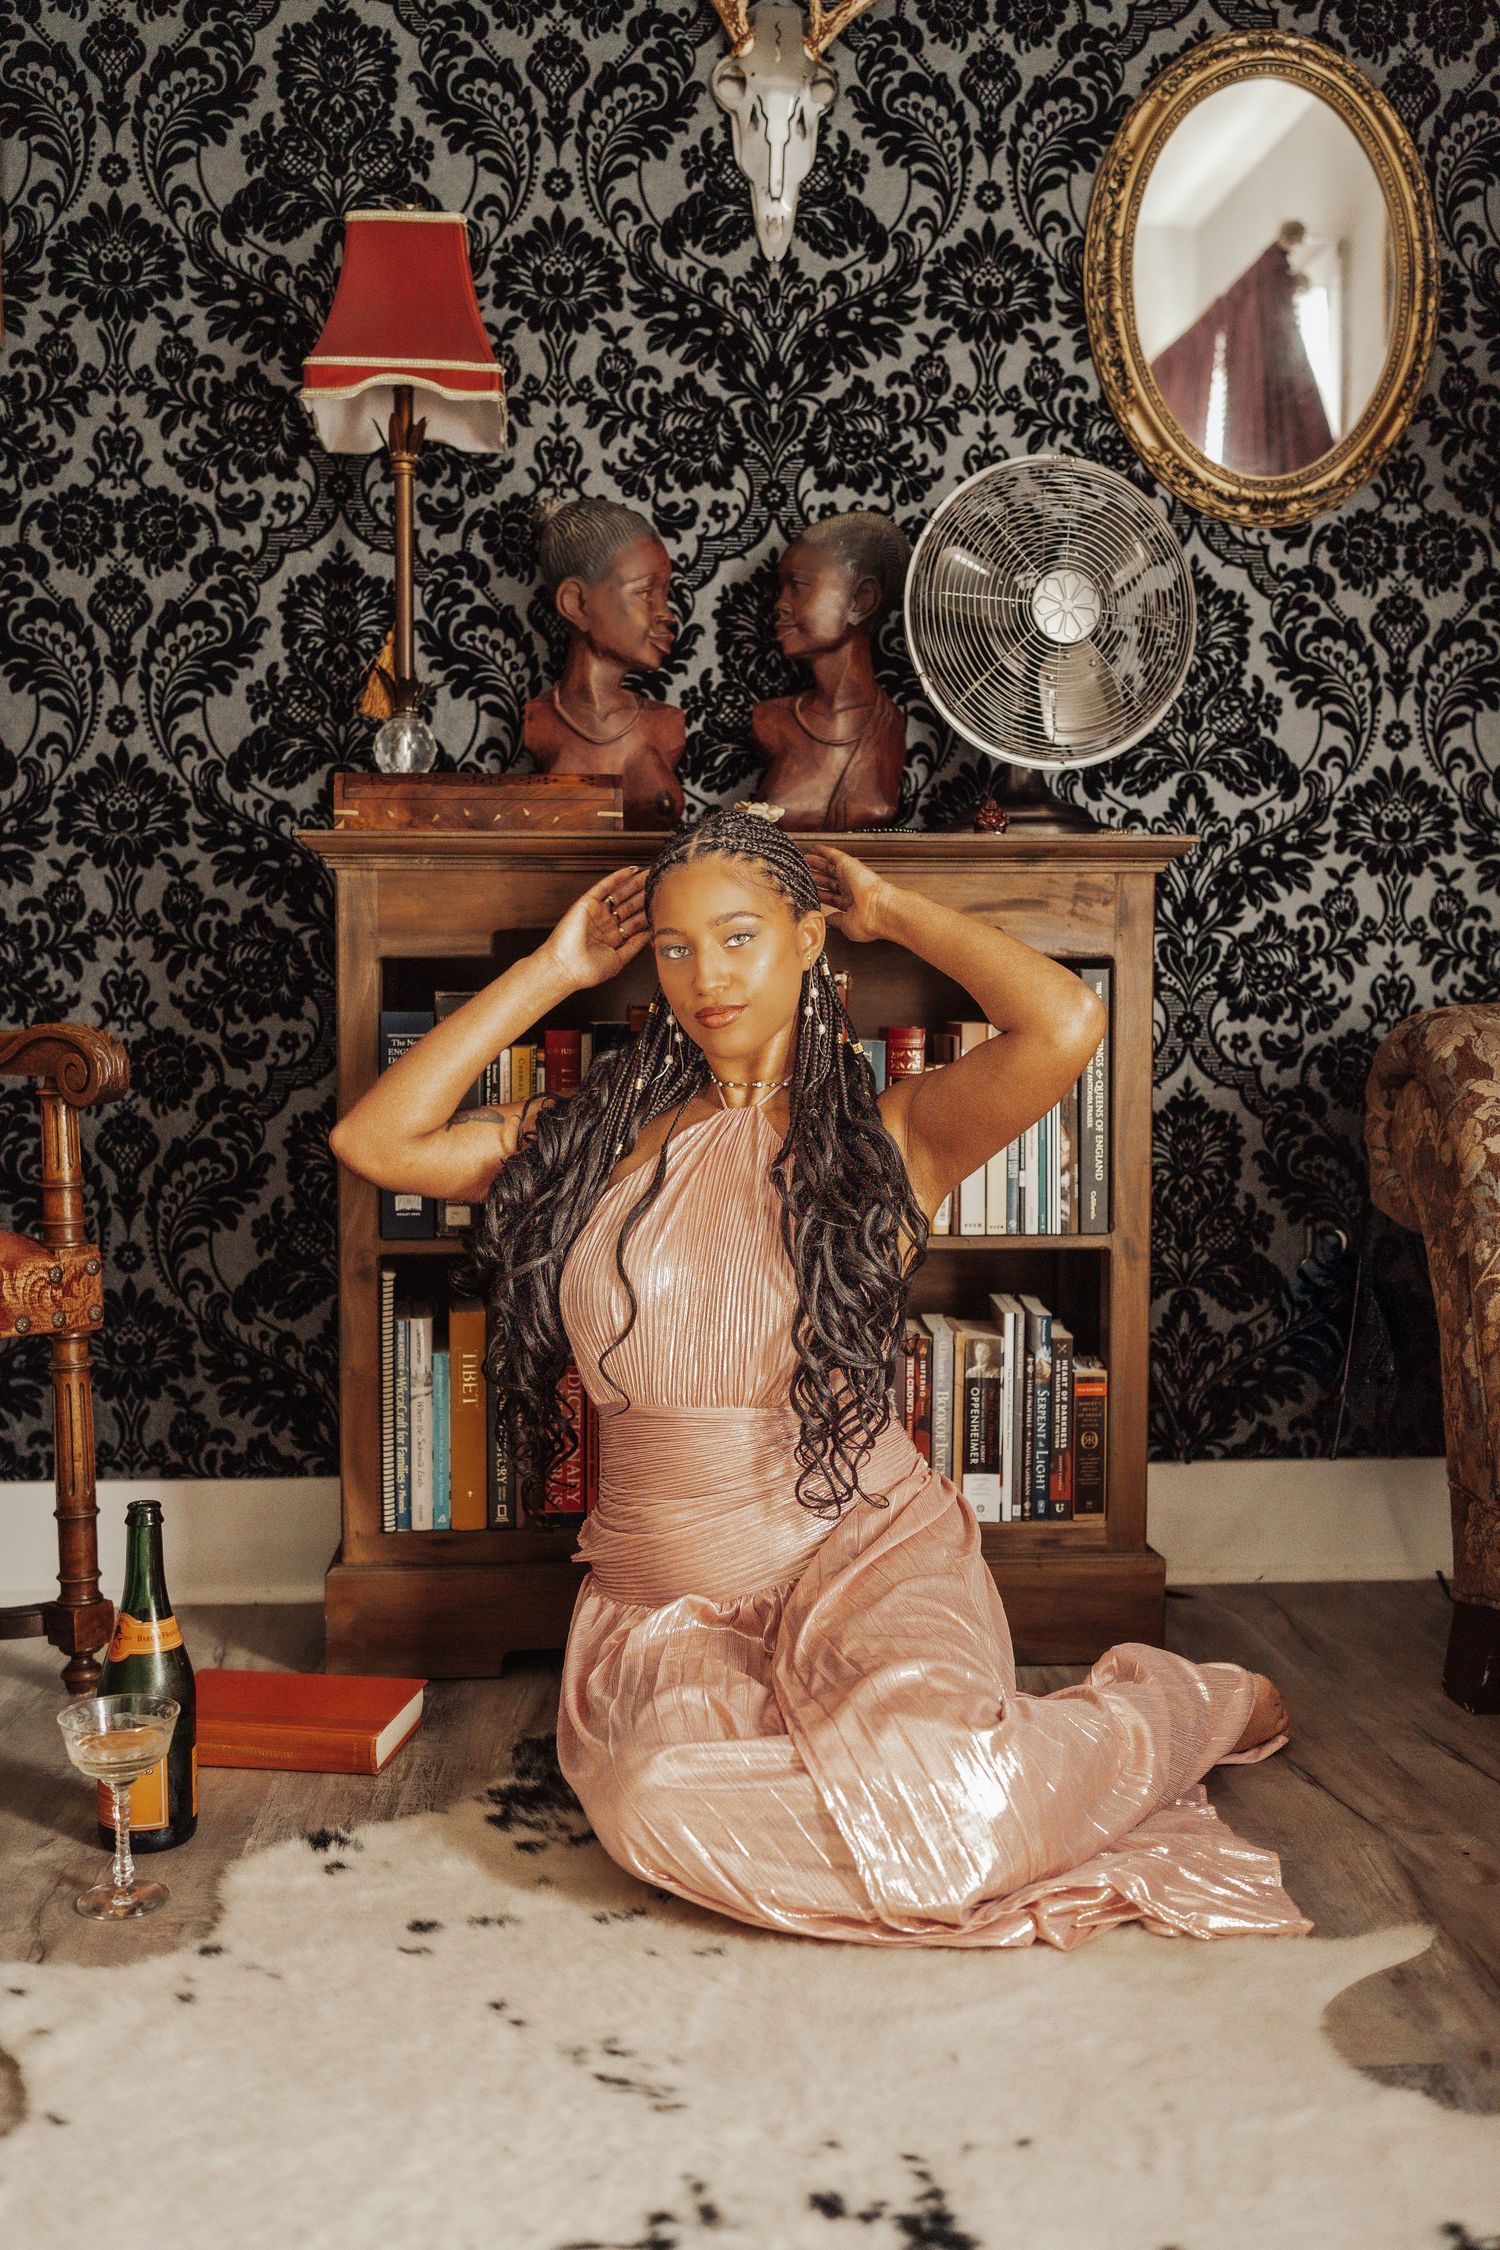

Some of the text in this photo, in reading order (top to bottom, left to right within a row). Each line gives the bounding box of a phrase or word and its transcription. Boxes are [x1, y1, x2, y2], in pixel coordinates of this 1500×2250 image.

[1094, 1080, 1103, 1117] QUEENS
[1095, 1119, 1103, 1133] OF
[1095, 1134, 1103, 1181] ENGLAND
[462, 1349, 478, 1408] TIBET
[906, 1358, 915, 1378] THE
[919, 1360, 927, 1398] INFERNO
[396, 1376, 408, 1429] WiccaCraft
[906, 1378, 915, 1413] CROWD
[1036, 1390, 1050, 1439] SERPENT
[1061, 1390, 1068, 1402] OF
[396, 1431, 408, 1445] for
[969, 1387, 980, 1465] OPPENHEIMER
[1060, 1404, 1068, 1449] DARKNESS
[396, 1447, 408, 1484] Families
[1035, 1450, 1049, 1490] LIGHT
